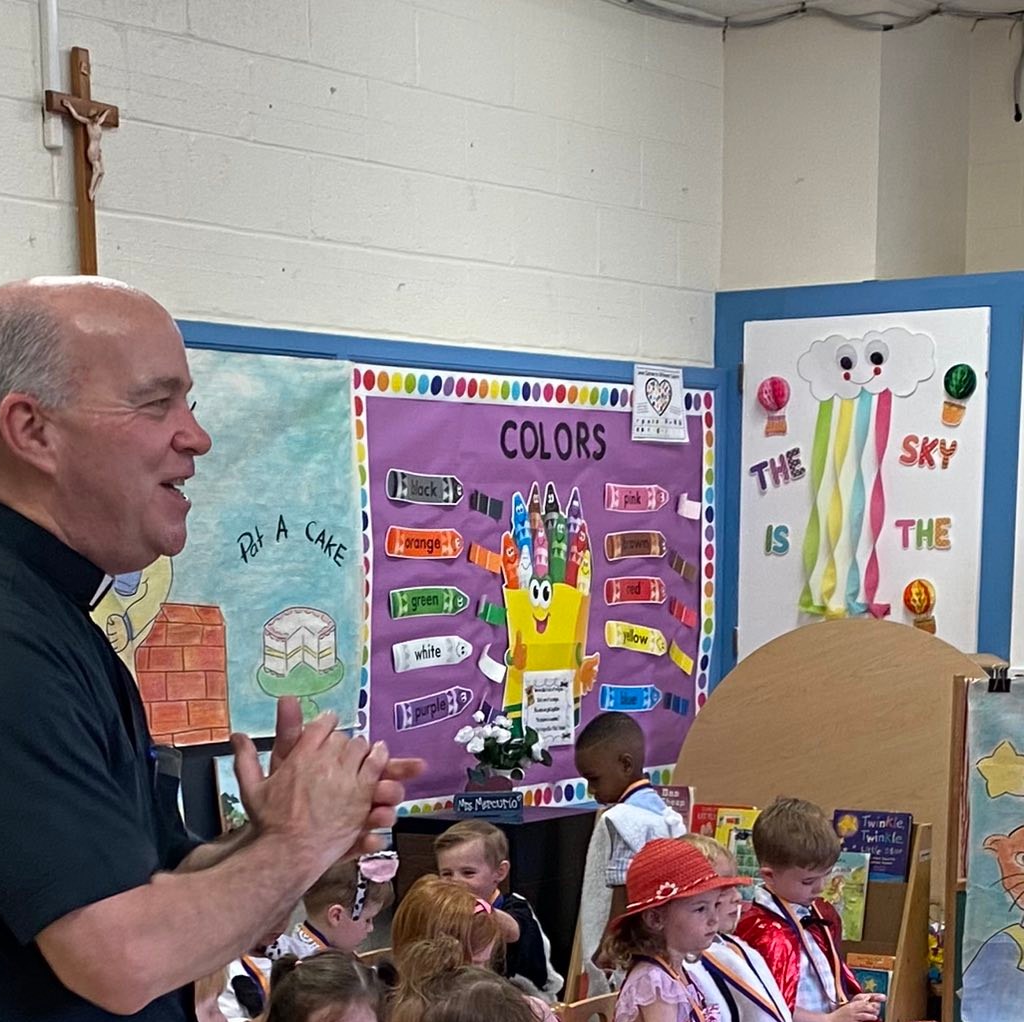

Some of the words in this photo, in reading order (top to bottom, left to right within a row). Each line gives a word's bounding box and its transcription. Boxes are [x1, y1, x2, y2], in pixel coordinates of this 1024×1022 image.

[499, 419, 607, 461] COLORS
[750, 447, 806, 493] THE
[899, 434, 958, 470] SKY
[411, 479, 438, 497] black
[624, 490, 641, 509] pink
[236, 525, 264, 564] Pat
[275, 514, 288, 543] A
[304, 520, 348, 567] CAKE
[404, 537, 441, 554] orange
[764, 524, 790, 556] IS
[895, 517, 952, 550] THE
[626, 581, 641, 595] red
[411, 594, 439, 611] green
[414, 644, 441, 661] white
[414, 697, 447, 722] purple
